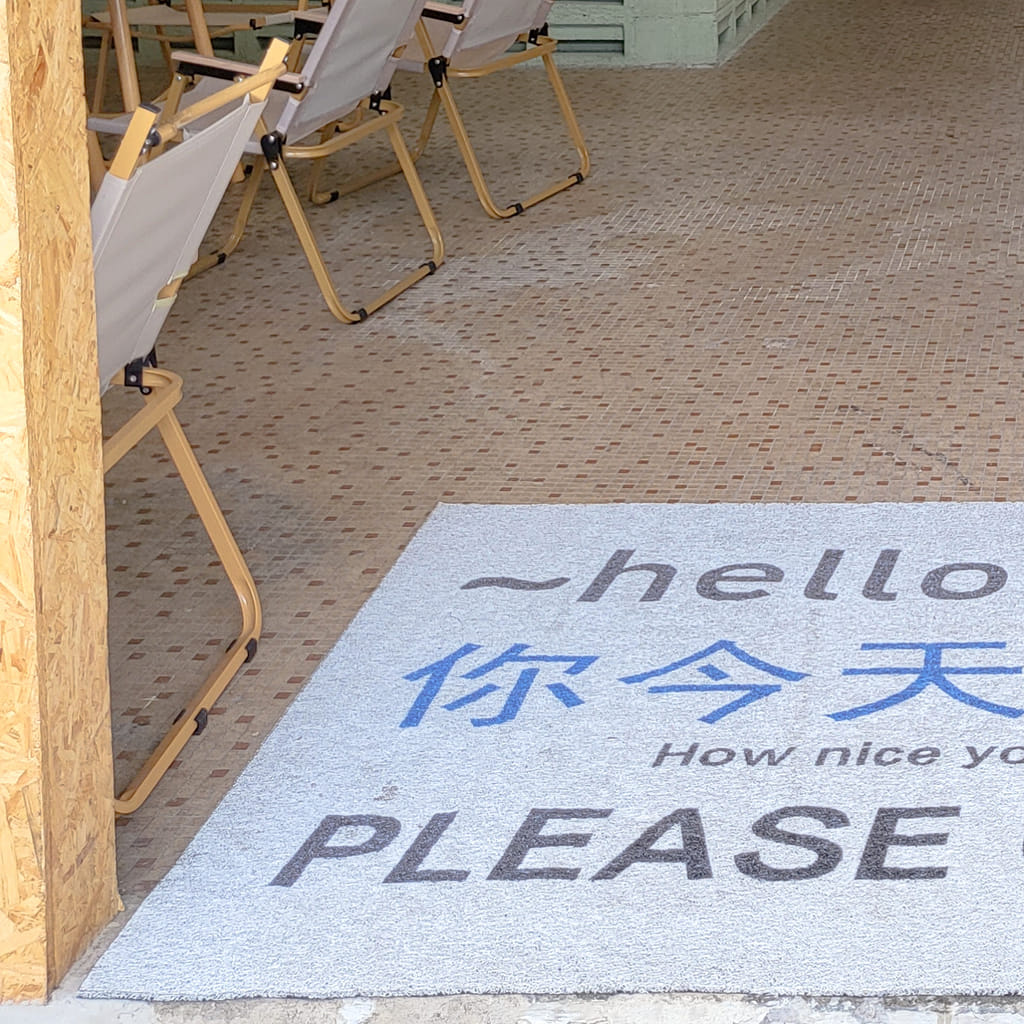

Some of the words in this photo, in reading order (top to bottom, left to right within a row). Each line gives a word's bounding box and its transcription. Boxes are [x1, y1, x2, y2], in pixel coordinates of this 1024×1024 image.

[652, 742, 796, 768] How
[815, 741, 941, 766] nice
[269, 802, 961, 888] PLEASE
